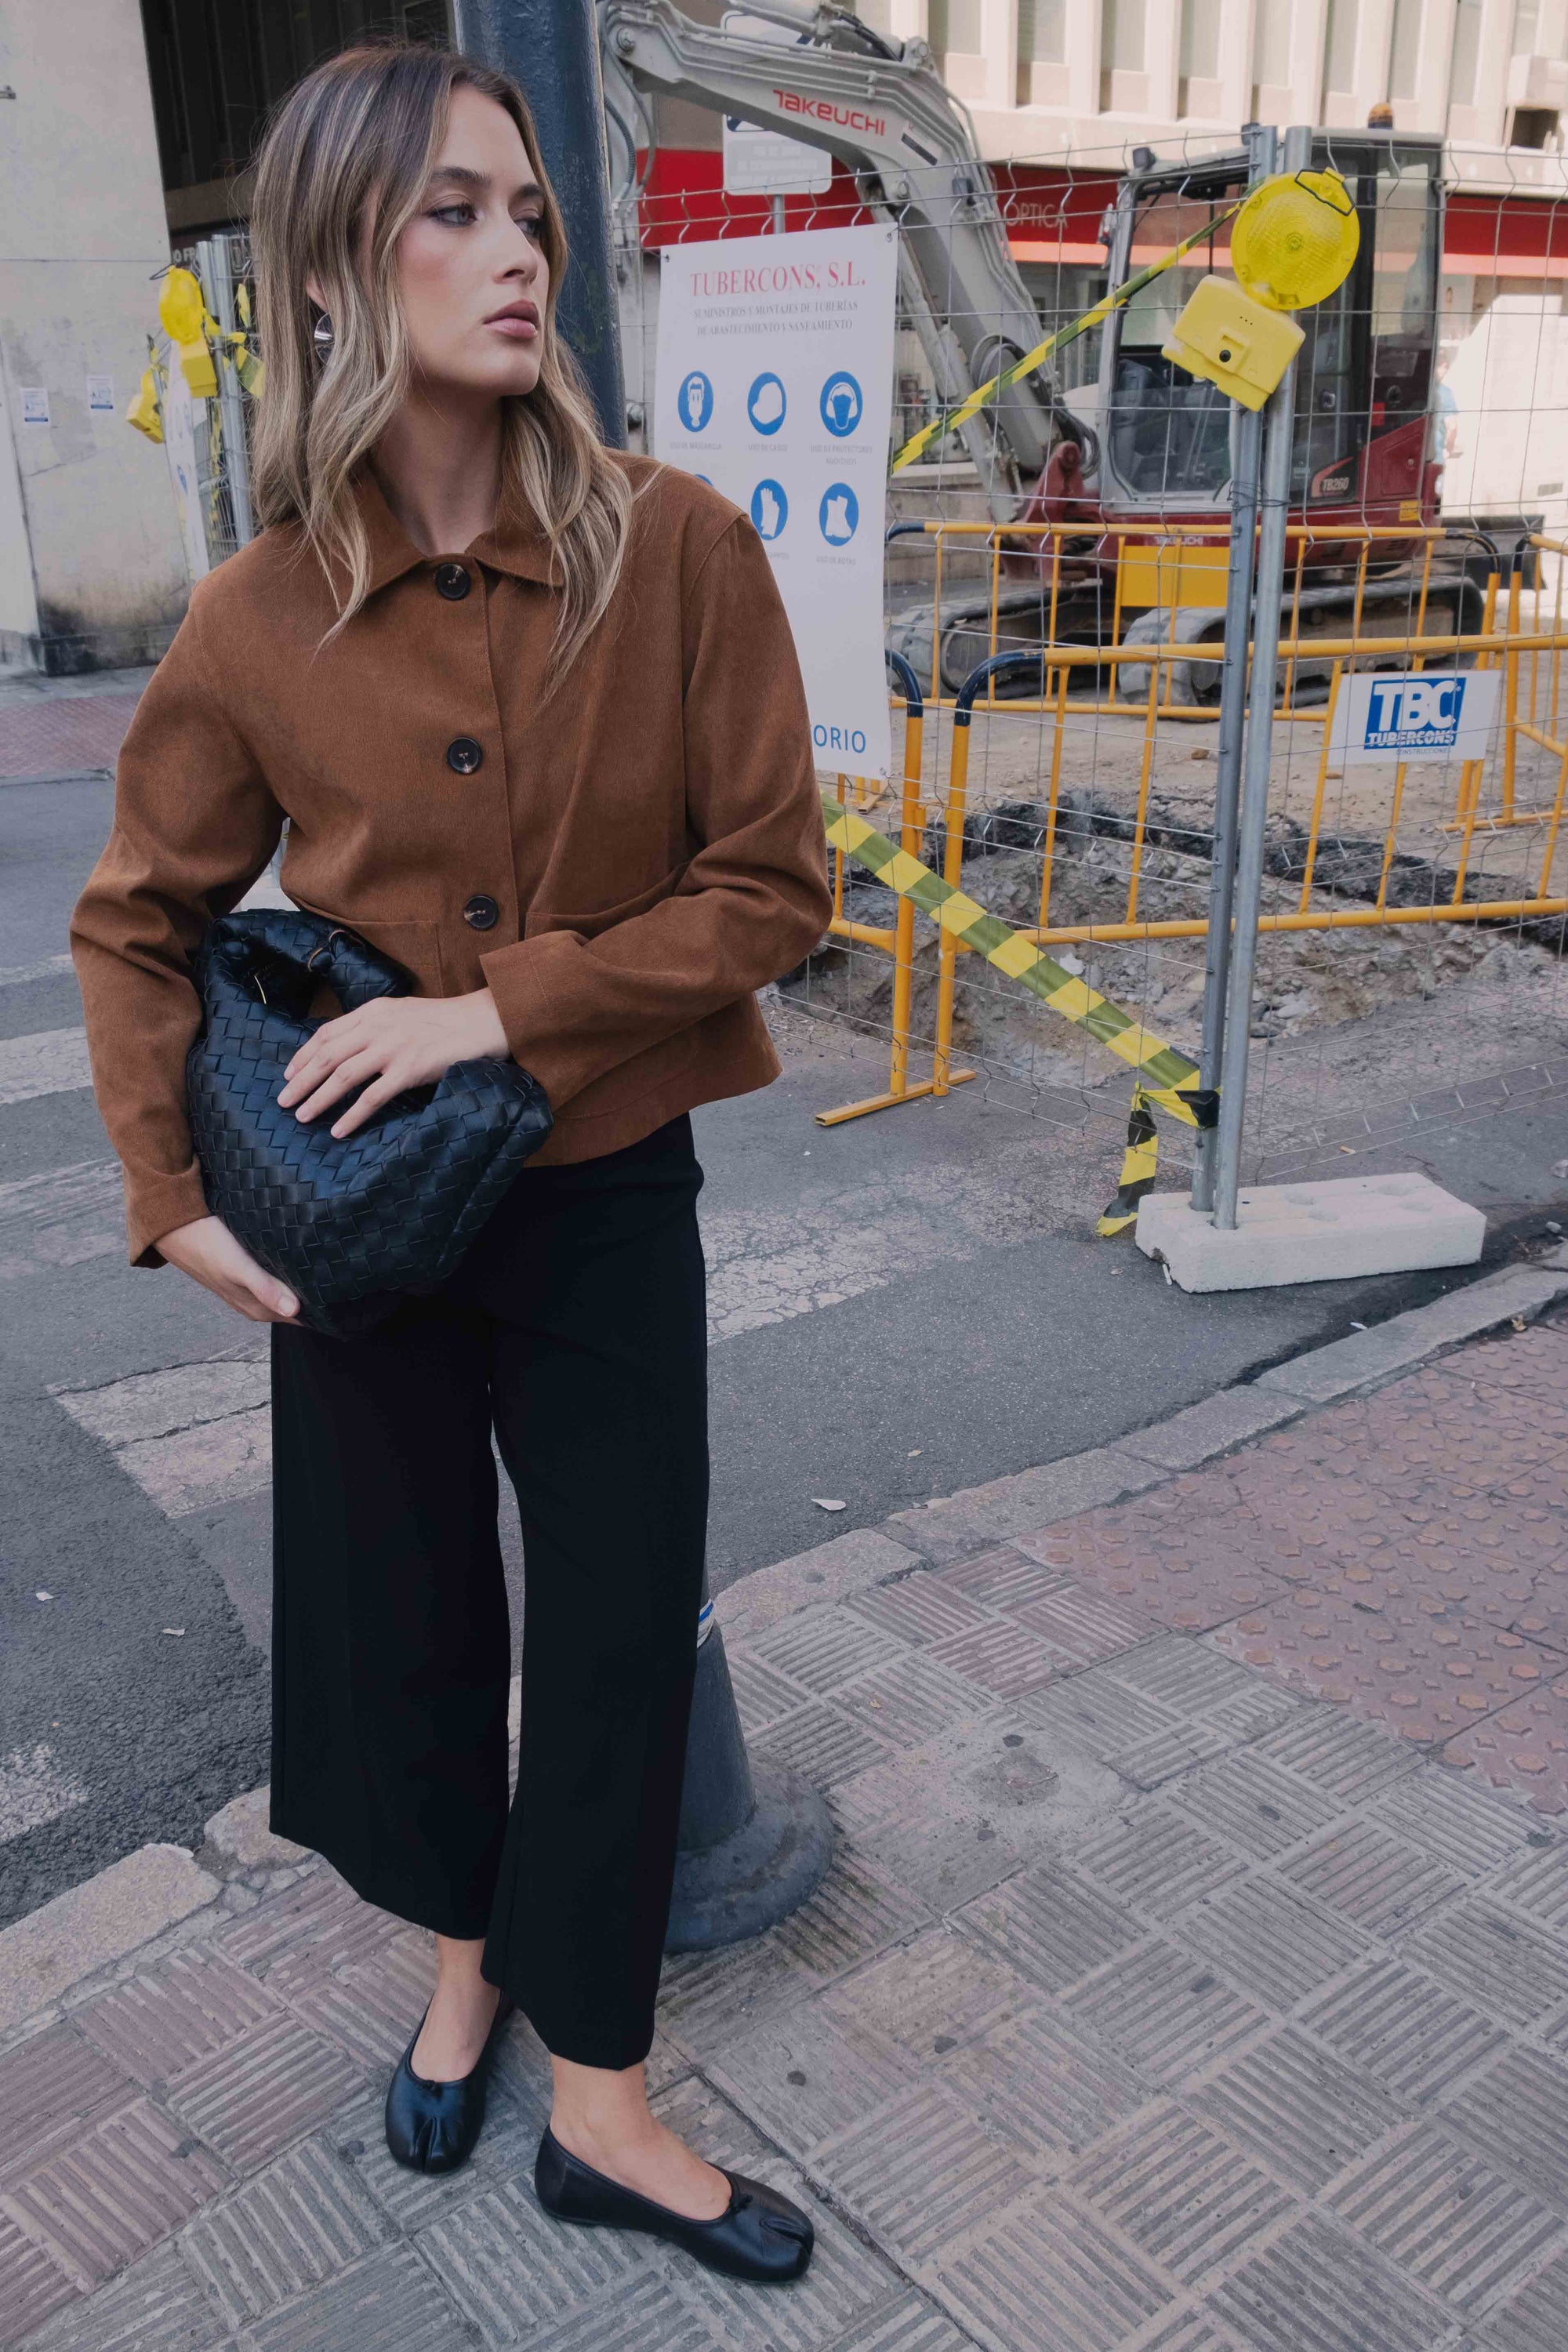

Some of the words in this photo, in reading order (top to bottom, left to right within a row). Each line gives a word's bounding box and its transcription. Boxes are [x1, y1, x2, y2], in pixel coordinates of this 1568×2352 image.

[690, 264, 820, 296] TUBERCONS,
[828, 261, 866, 288] S.L.
[755, 303, 798, 315] MONTAJES
[800, 303, 810, 313] DE
[789, 318, 853, 331] SANEAMIENTO
[1374, 681, 1457, 732] TBC
[1367, 729, 1454, 747] TUBERCONS
